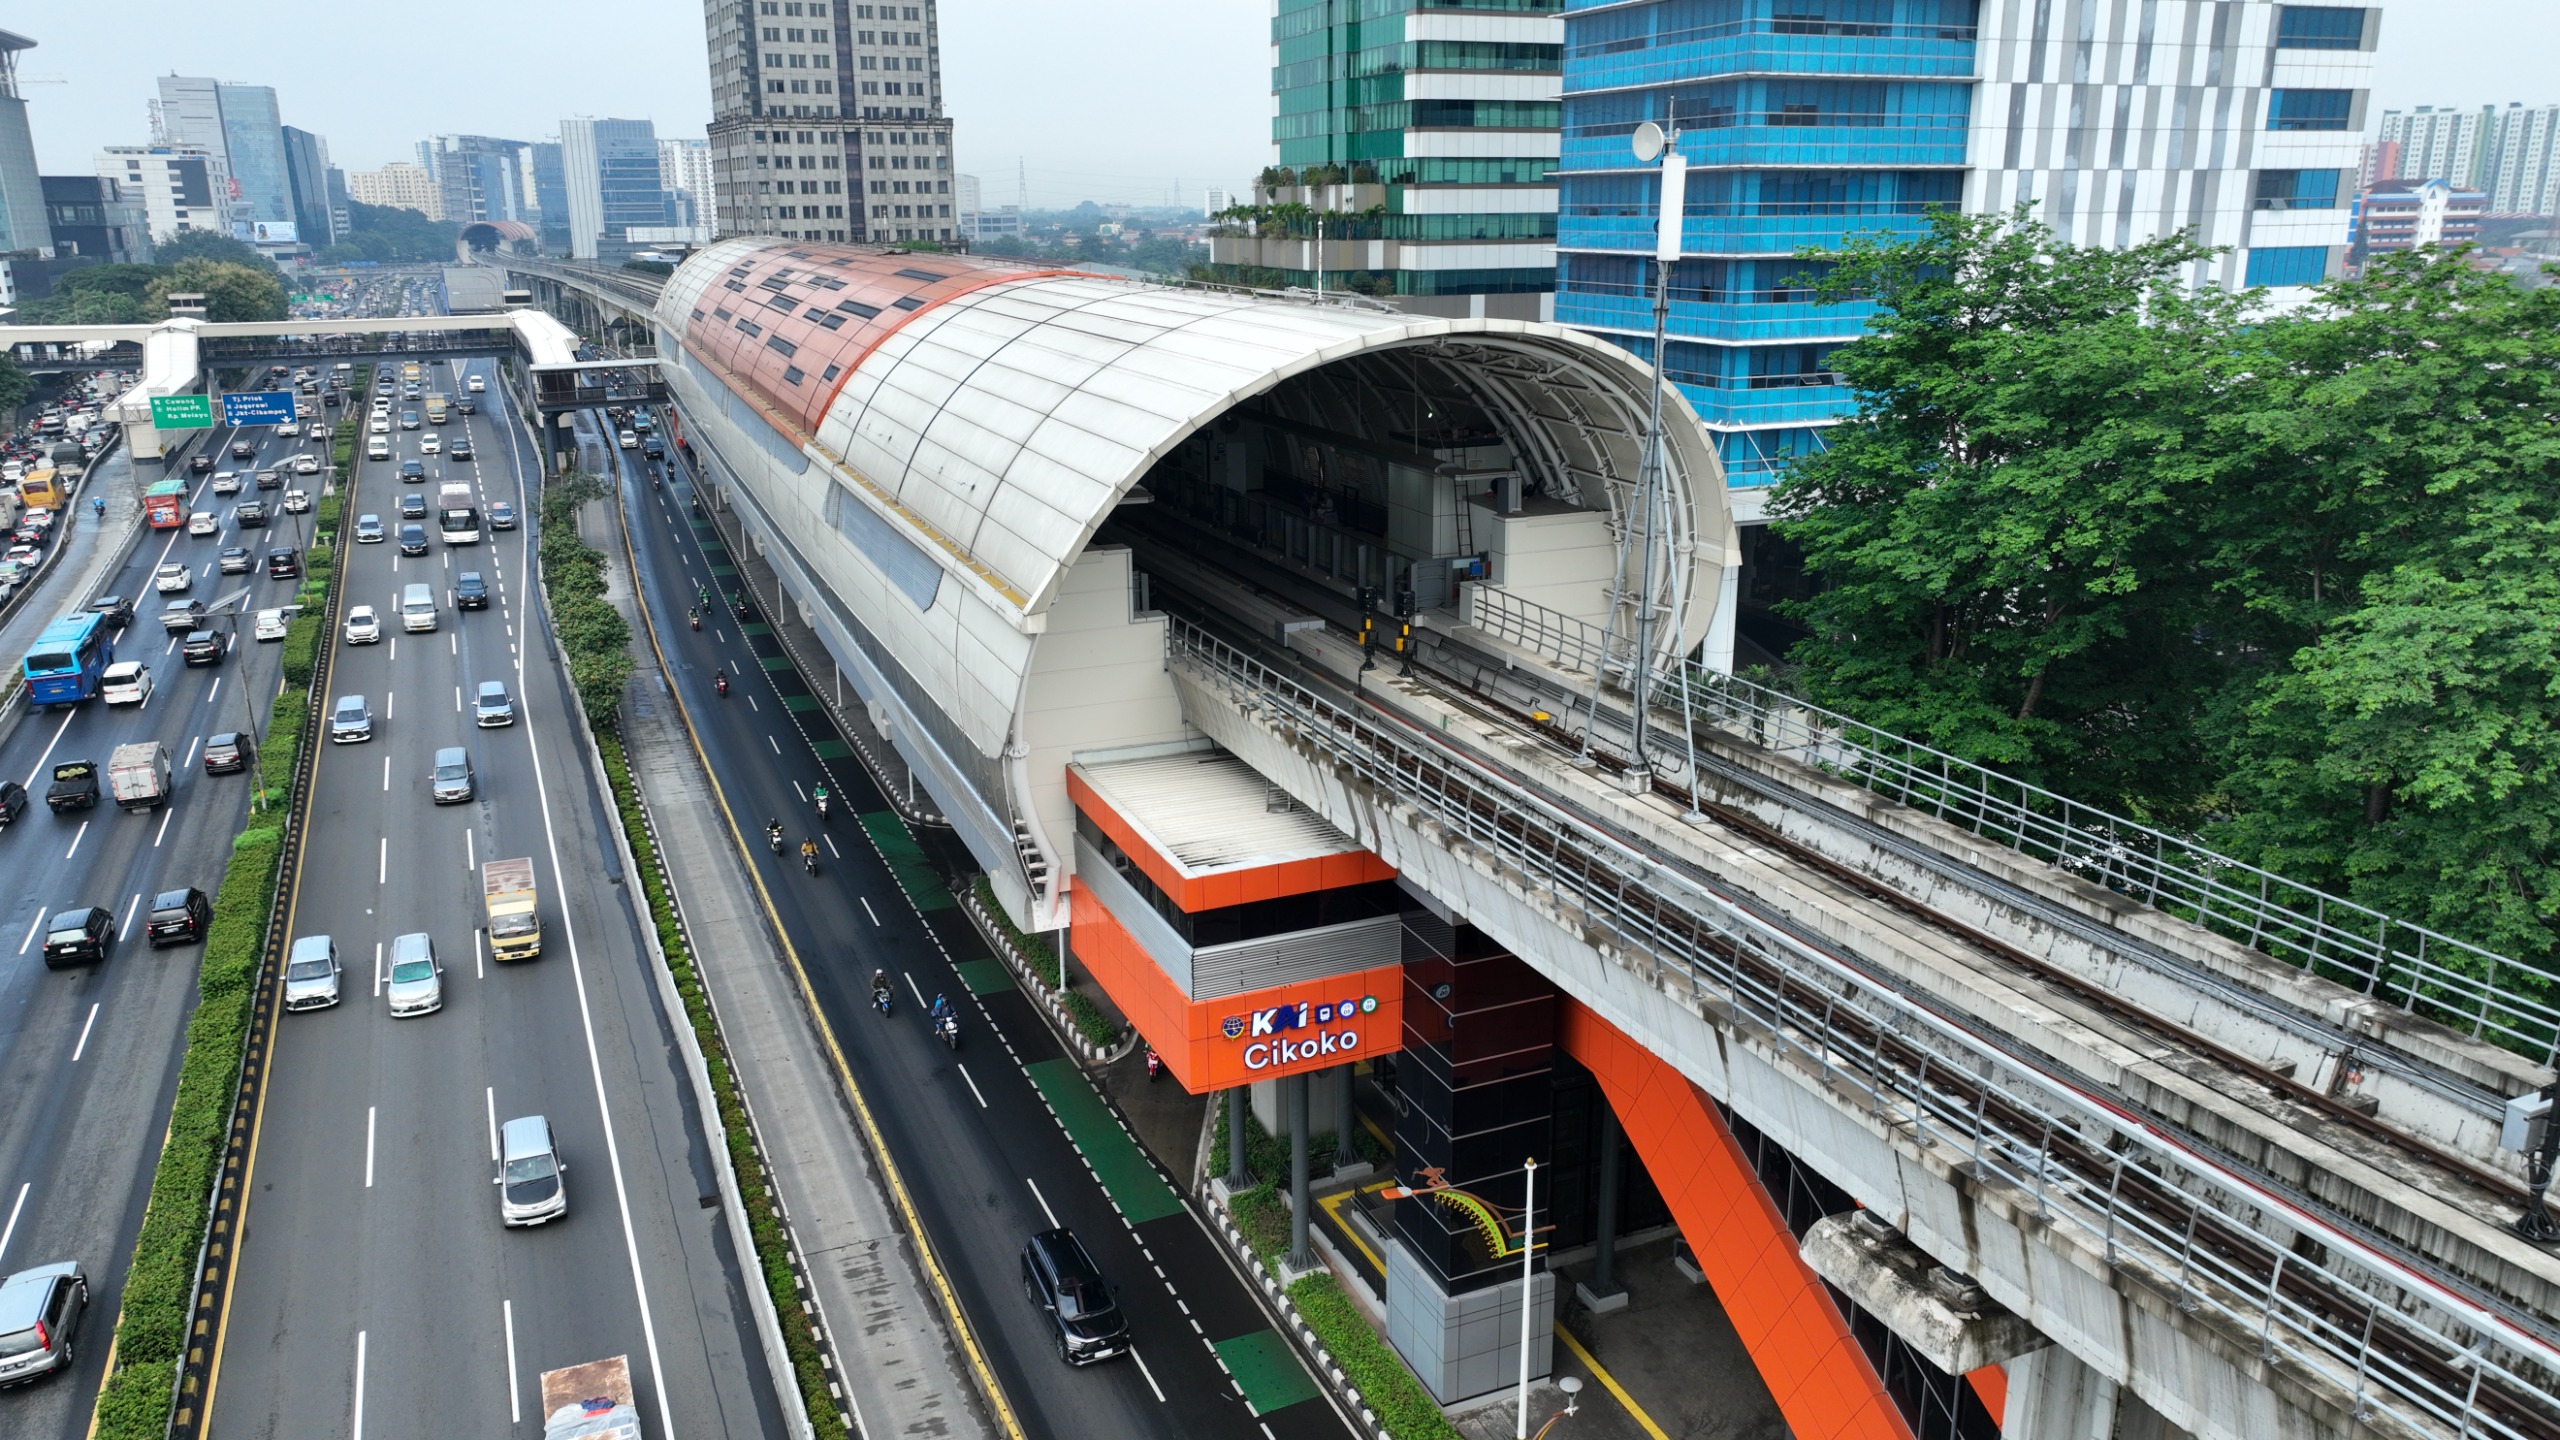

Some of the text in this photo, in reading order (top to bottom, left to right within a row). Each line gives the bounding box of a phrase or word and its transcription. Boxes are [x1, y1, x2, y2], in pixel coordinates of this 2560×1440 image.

[234, 402, 268, 410] Jagorawi
[235, 408, 287, 416] Jkt-Cikampek
[1251, 1001, 1309, 1037] KAI
[1244, 1030, 1358, 1069] Cikoko
